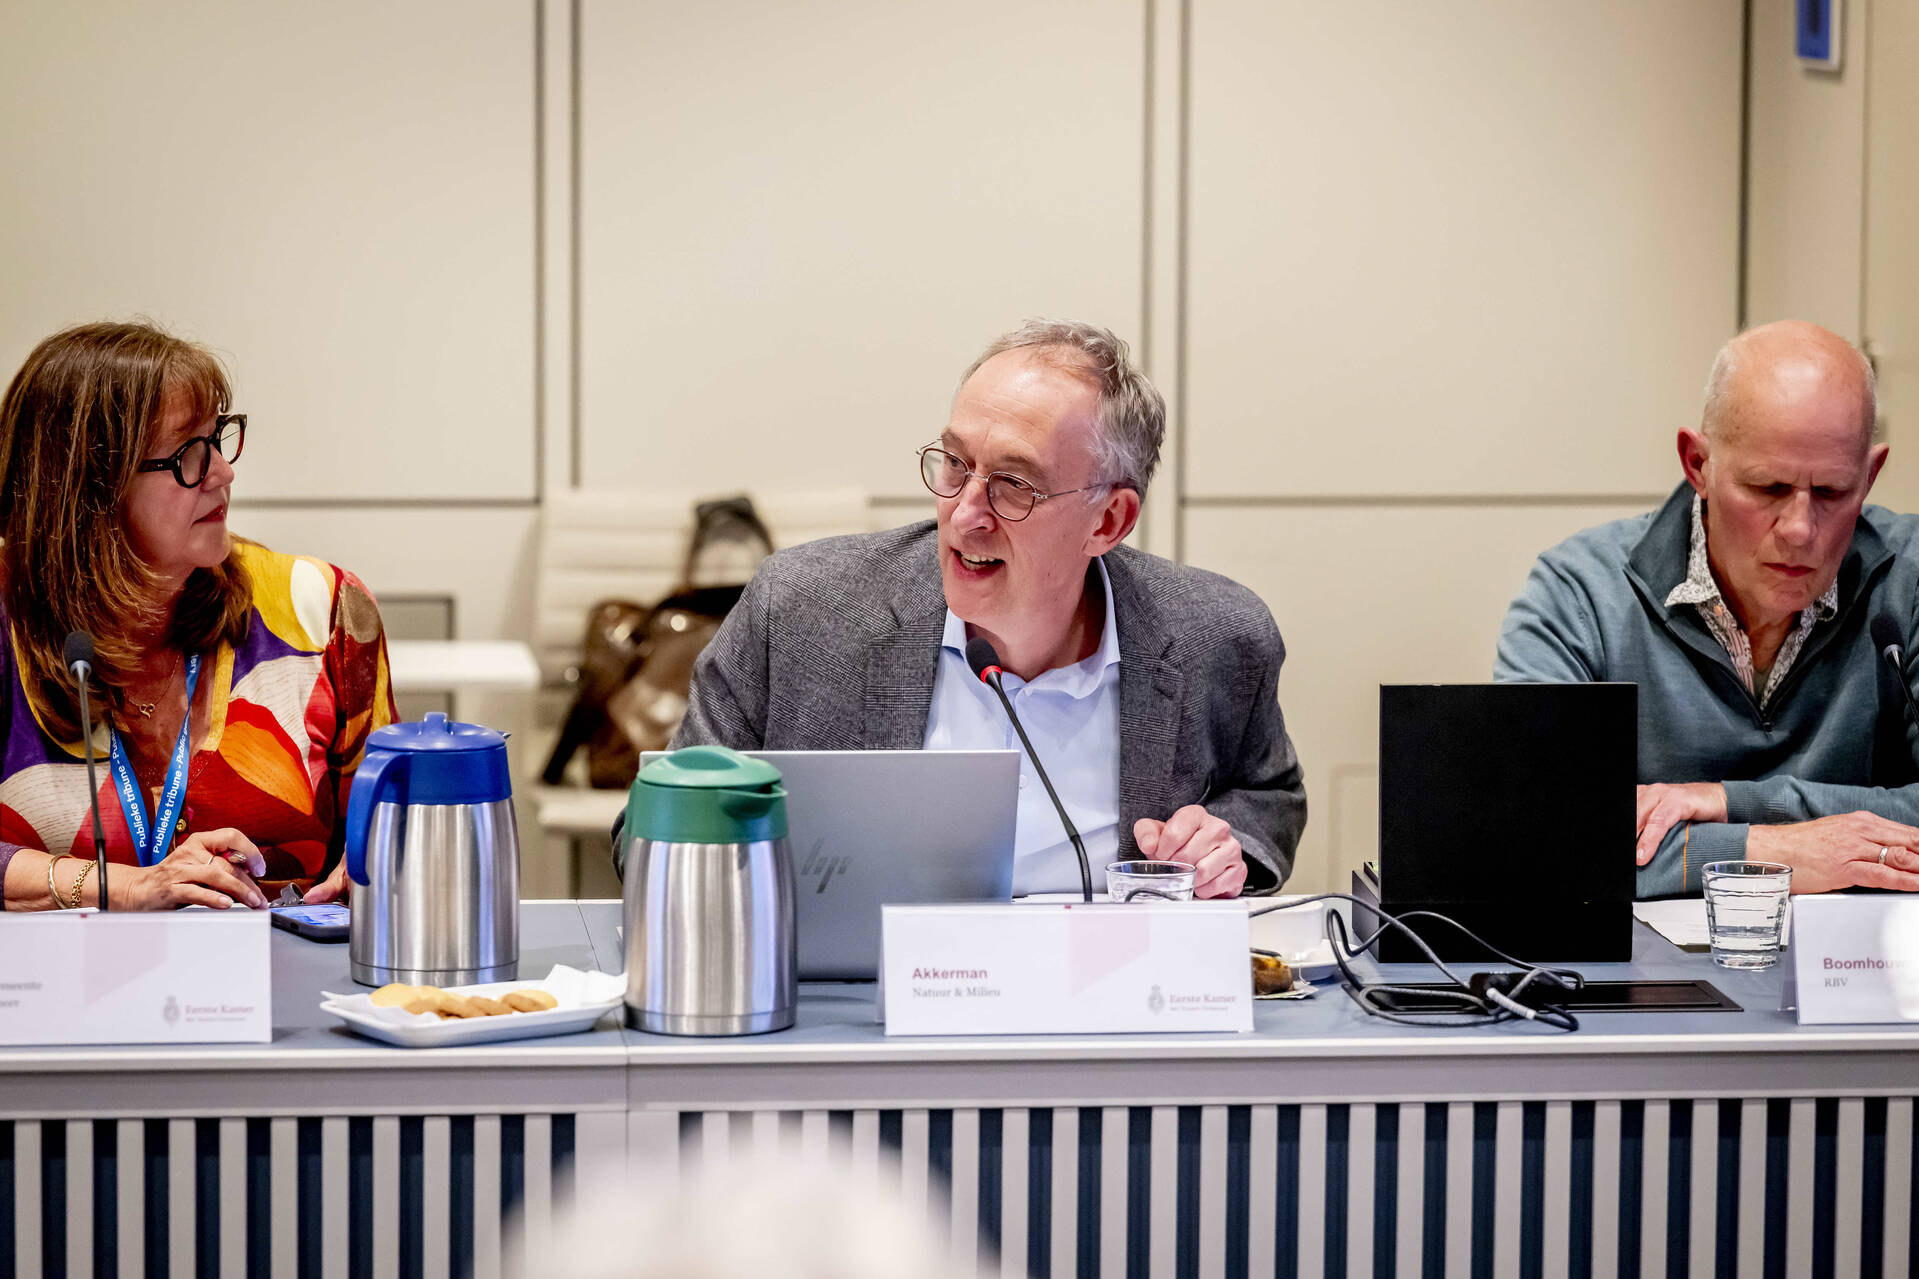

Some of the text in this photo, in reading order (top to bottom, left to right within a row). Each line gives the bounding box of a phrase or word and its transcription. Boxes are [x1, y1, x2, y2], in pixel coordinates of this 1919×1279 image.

[118, 765, 136, 803] tribune
[152, 809, 172, 854] Publieke
[166, 771, 183, 808] tribune
[175, 735, 186, 765] Public
[130, 802, 147, 848] Publieke
[912, 967, 988, 980] Akkerman
[1824, 977, 1848, 987] RBV
[912, 986, 1001, 998] Natuur & Milieu
